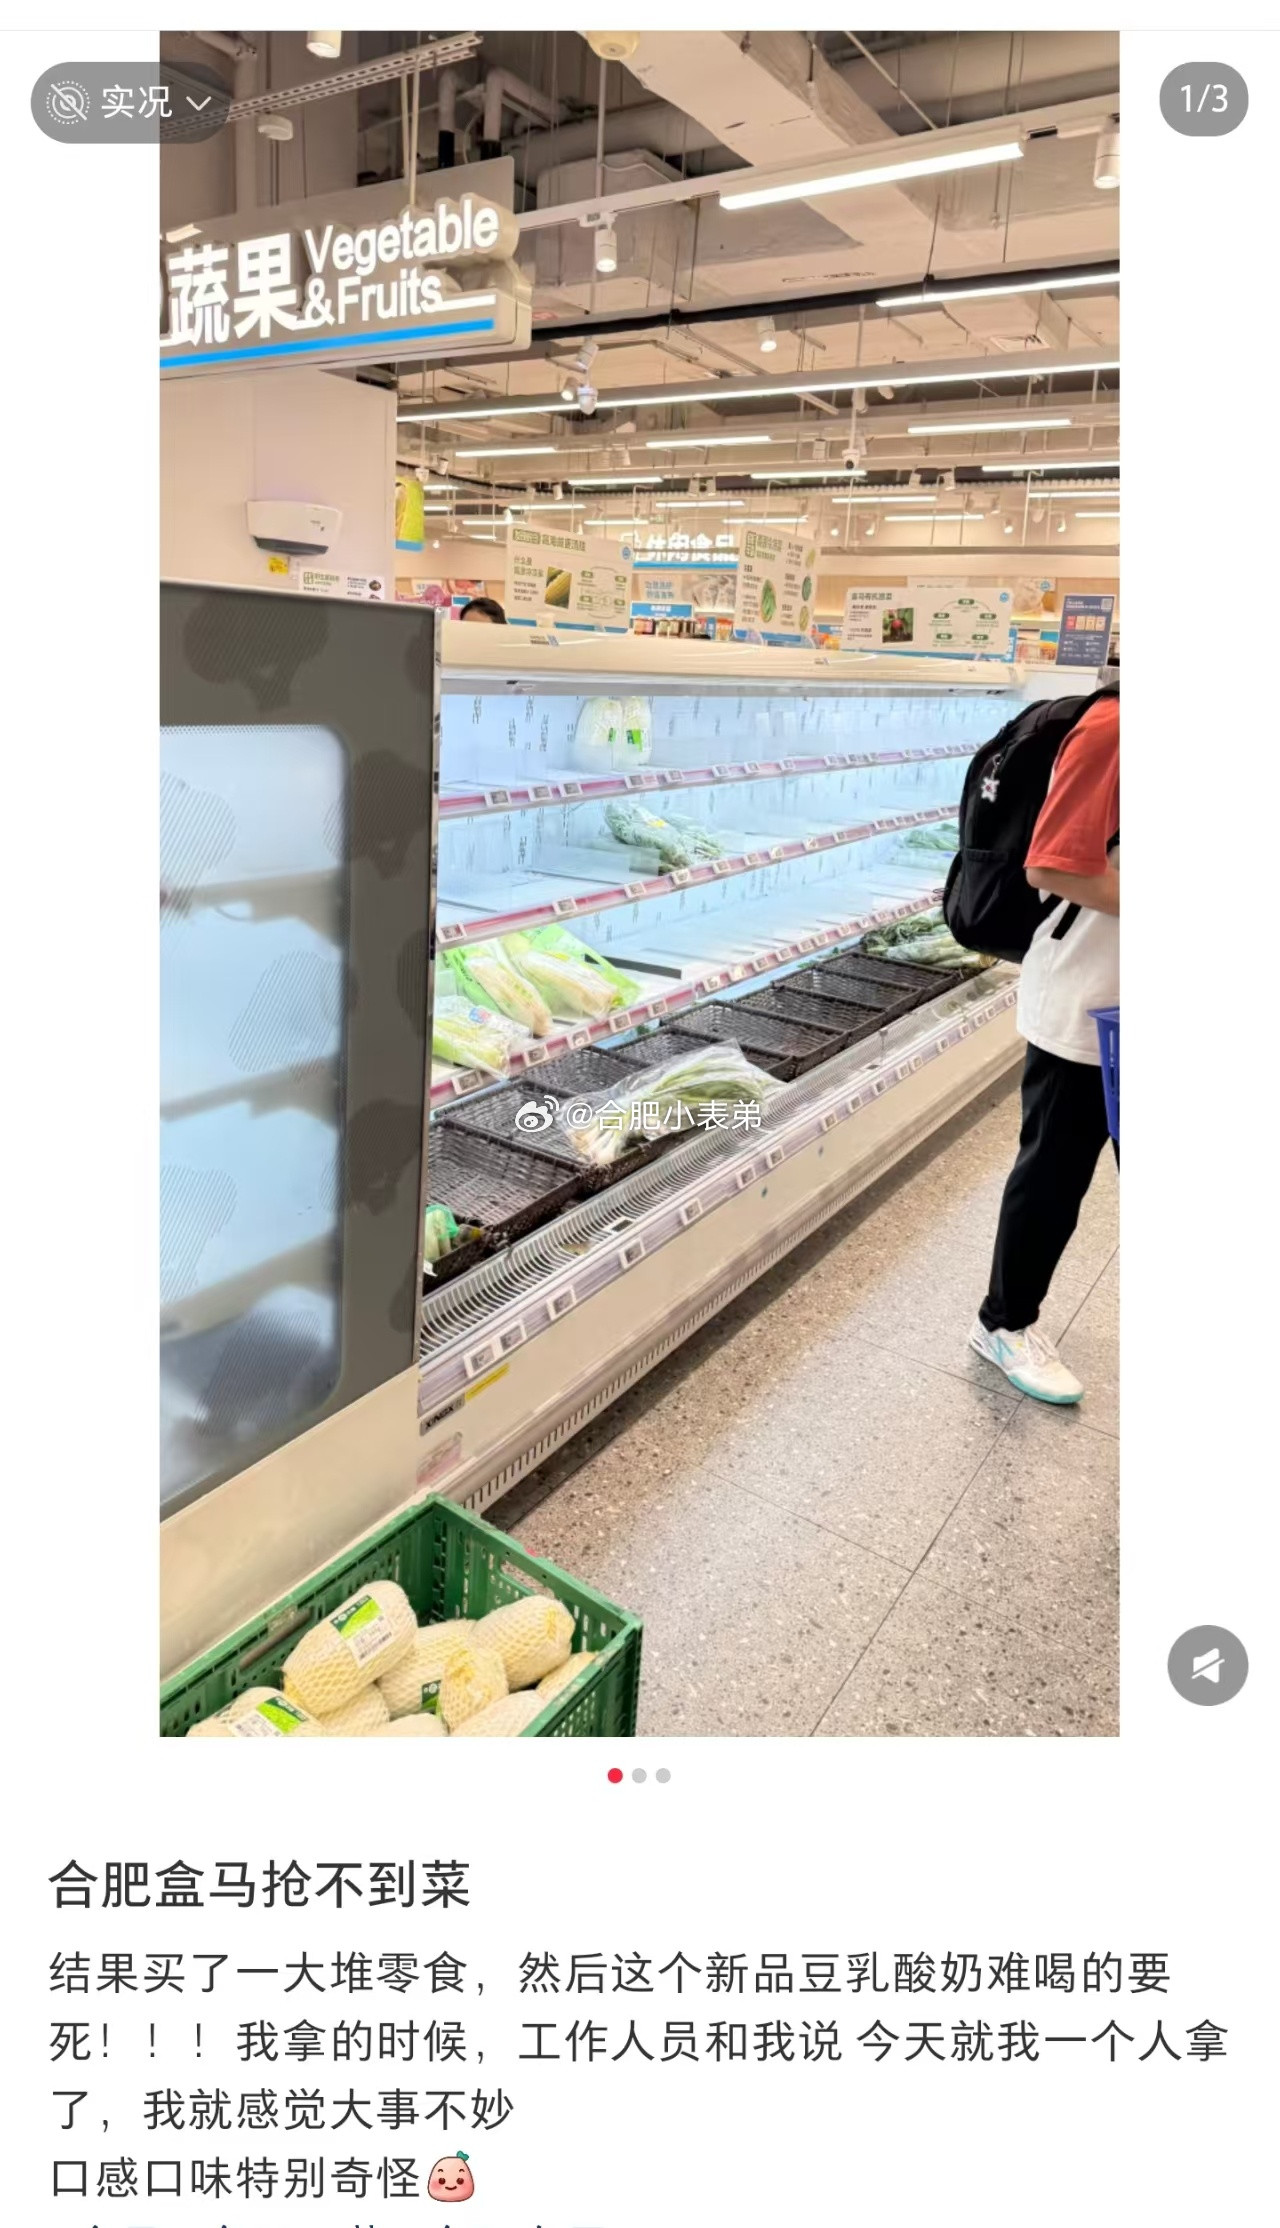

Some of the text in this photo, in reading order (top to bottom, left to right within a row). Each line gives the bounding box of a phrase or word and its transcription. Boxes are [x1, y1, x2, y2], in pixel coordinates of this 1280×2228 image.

[305, 199, 500, 276] Vegetable
[168, 233, 299, 346] 蔬果
[304, 267, 443, 328] &Fruits
